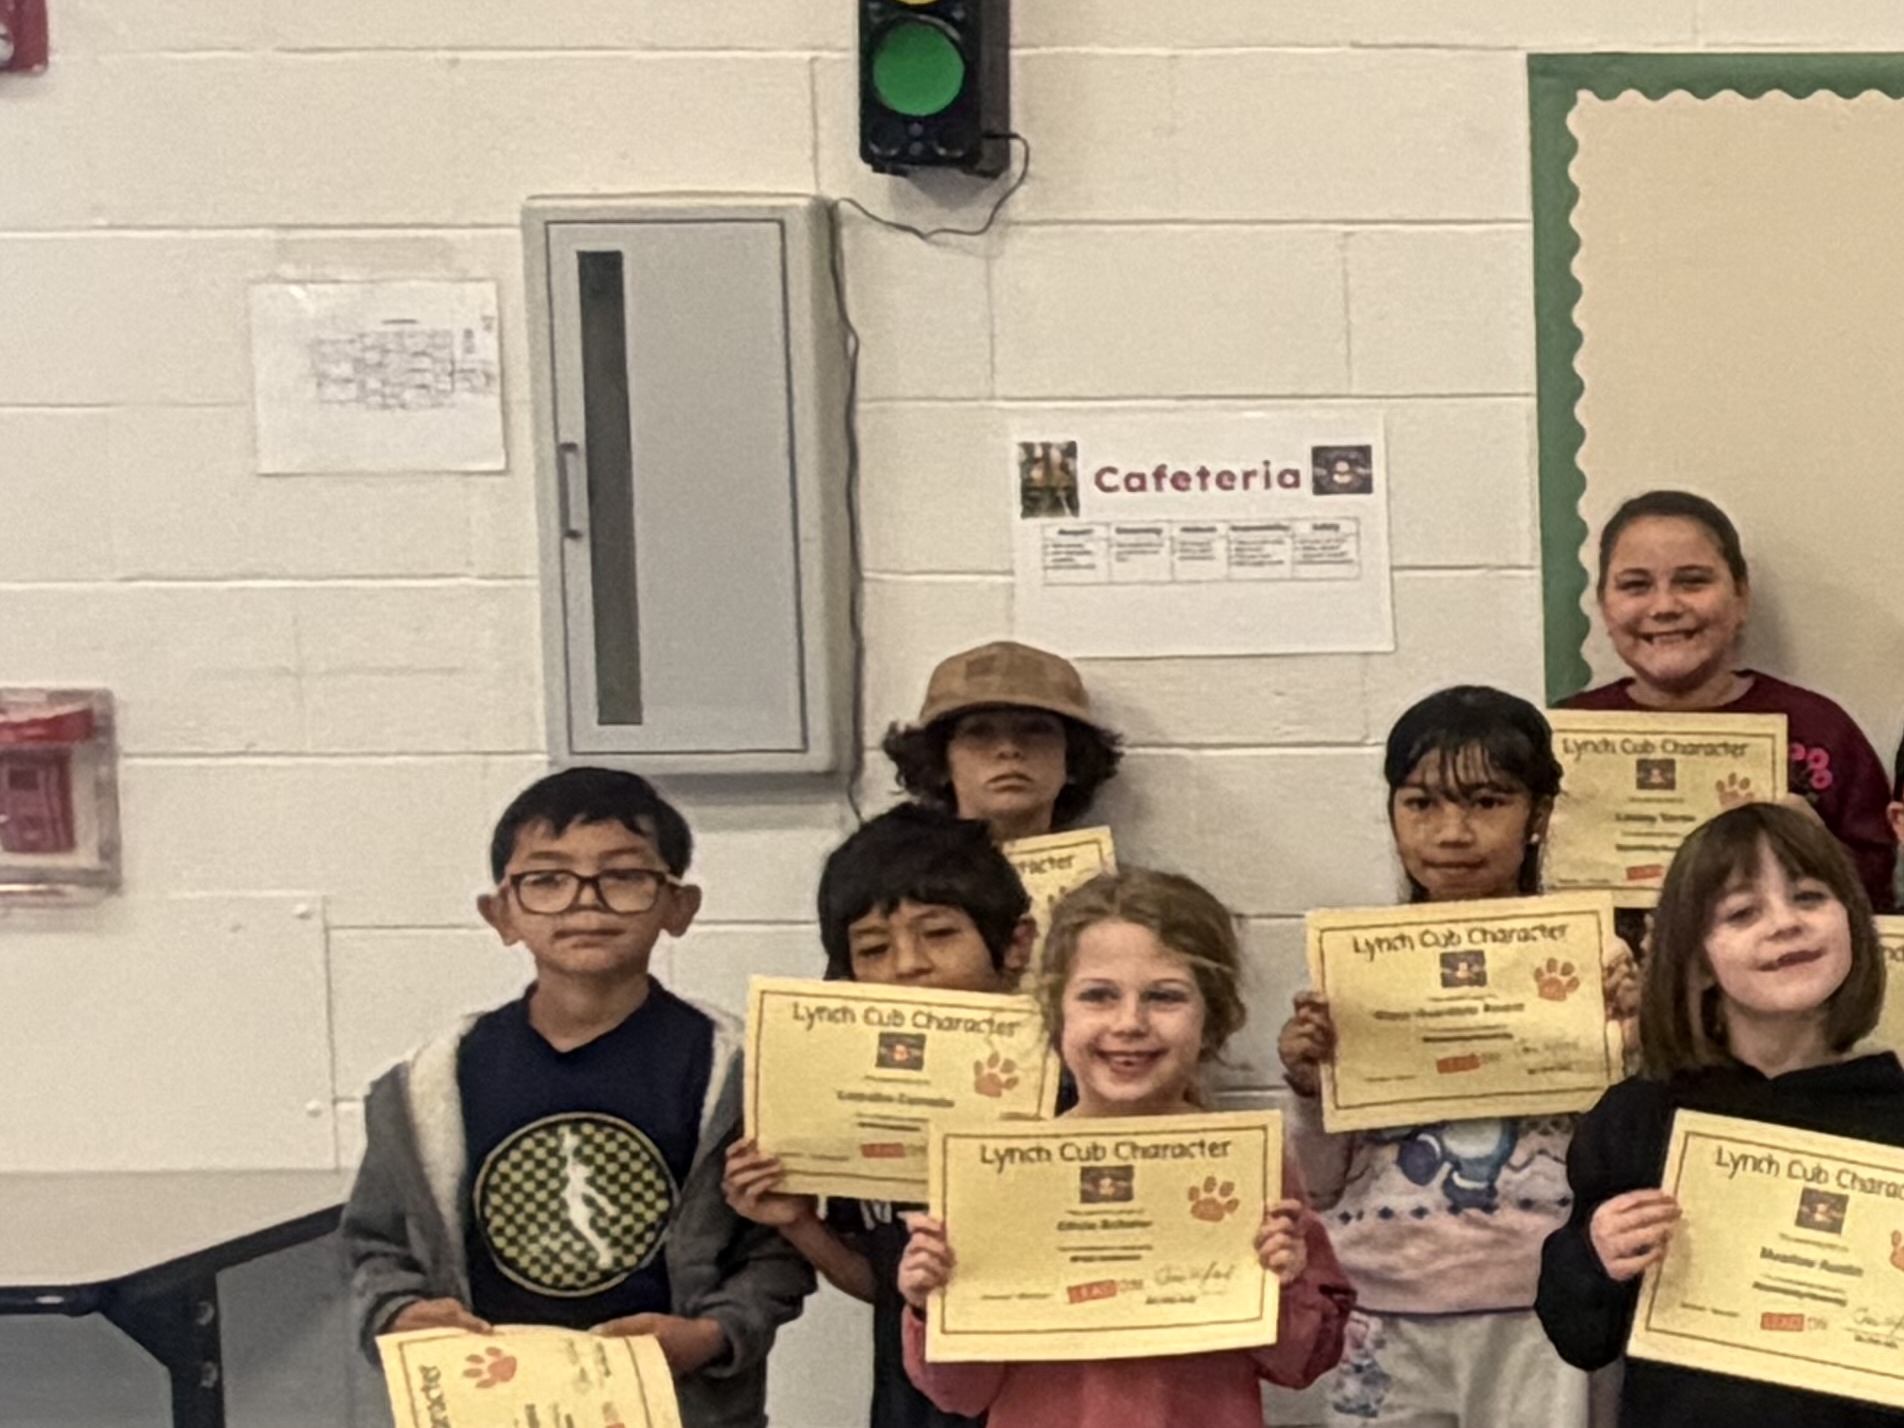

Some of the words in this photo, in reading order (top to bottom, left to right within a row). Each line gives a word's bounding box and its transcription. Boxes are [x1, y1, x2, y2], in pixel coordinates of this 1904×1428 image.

[1094, 460, 1302, 493] Cafeteria
[1621, 738, 1655, 755] Cub
[1419, 929, 1461, 948] Cub
[863, 1007, 905, 1028] Cub
[1059, 1141, 1106, 1162] Cub
[1787, 1159, 1829, 1184] Cub
